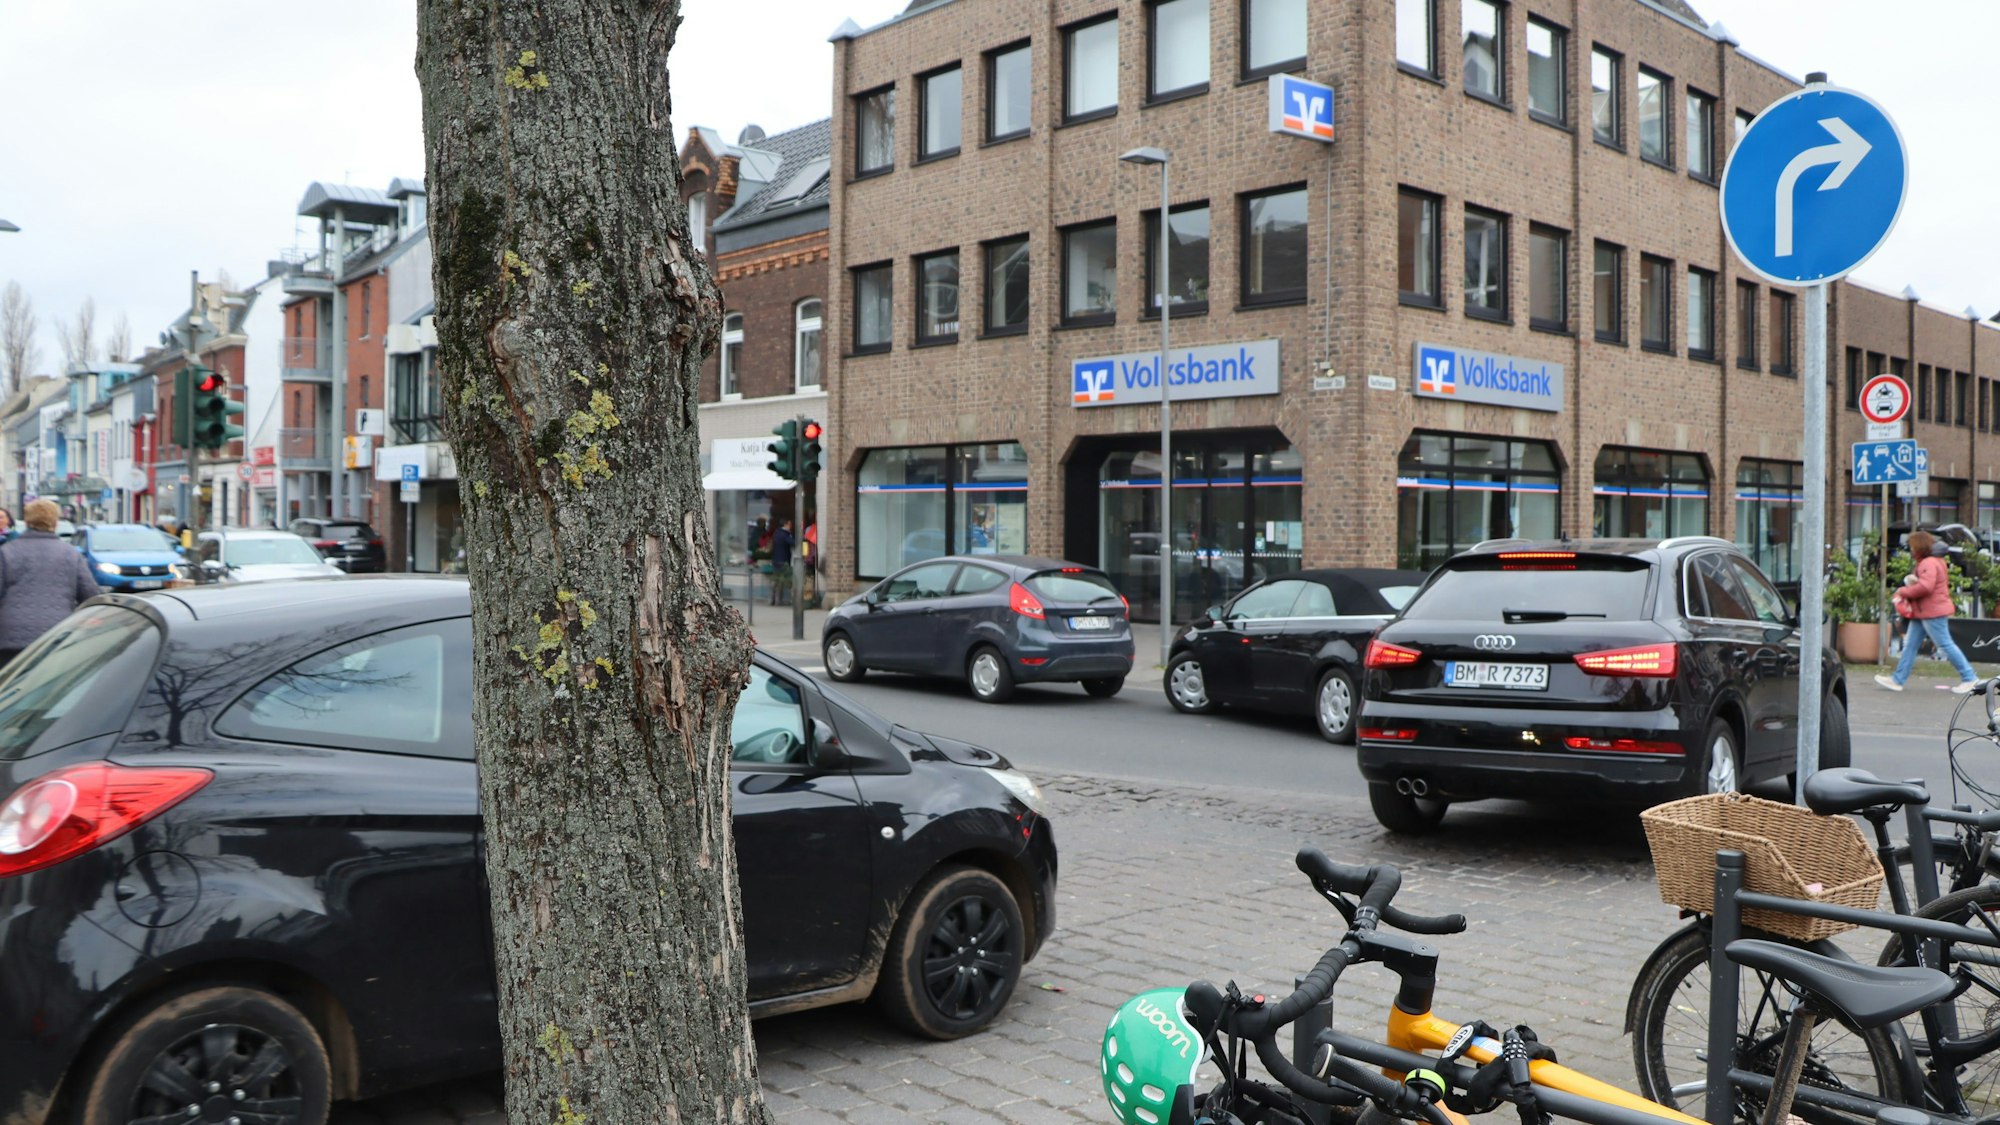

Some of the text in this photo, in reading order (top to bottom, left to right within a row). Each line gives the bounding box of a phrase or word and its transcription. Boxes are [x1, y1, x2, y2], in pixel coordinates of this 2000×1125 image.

[1460, 355, 1552, 397] Volksbank
[1455, 664, 1545, 684] BM R 7373
[1135, 998, 1192, 1059] woom
[1446, 1028, 1468, 1052] ABUS
